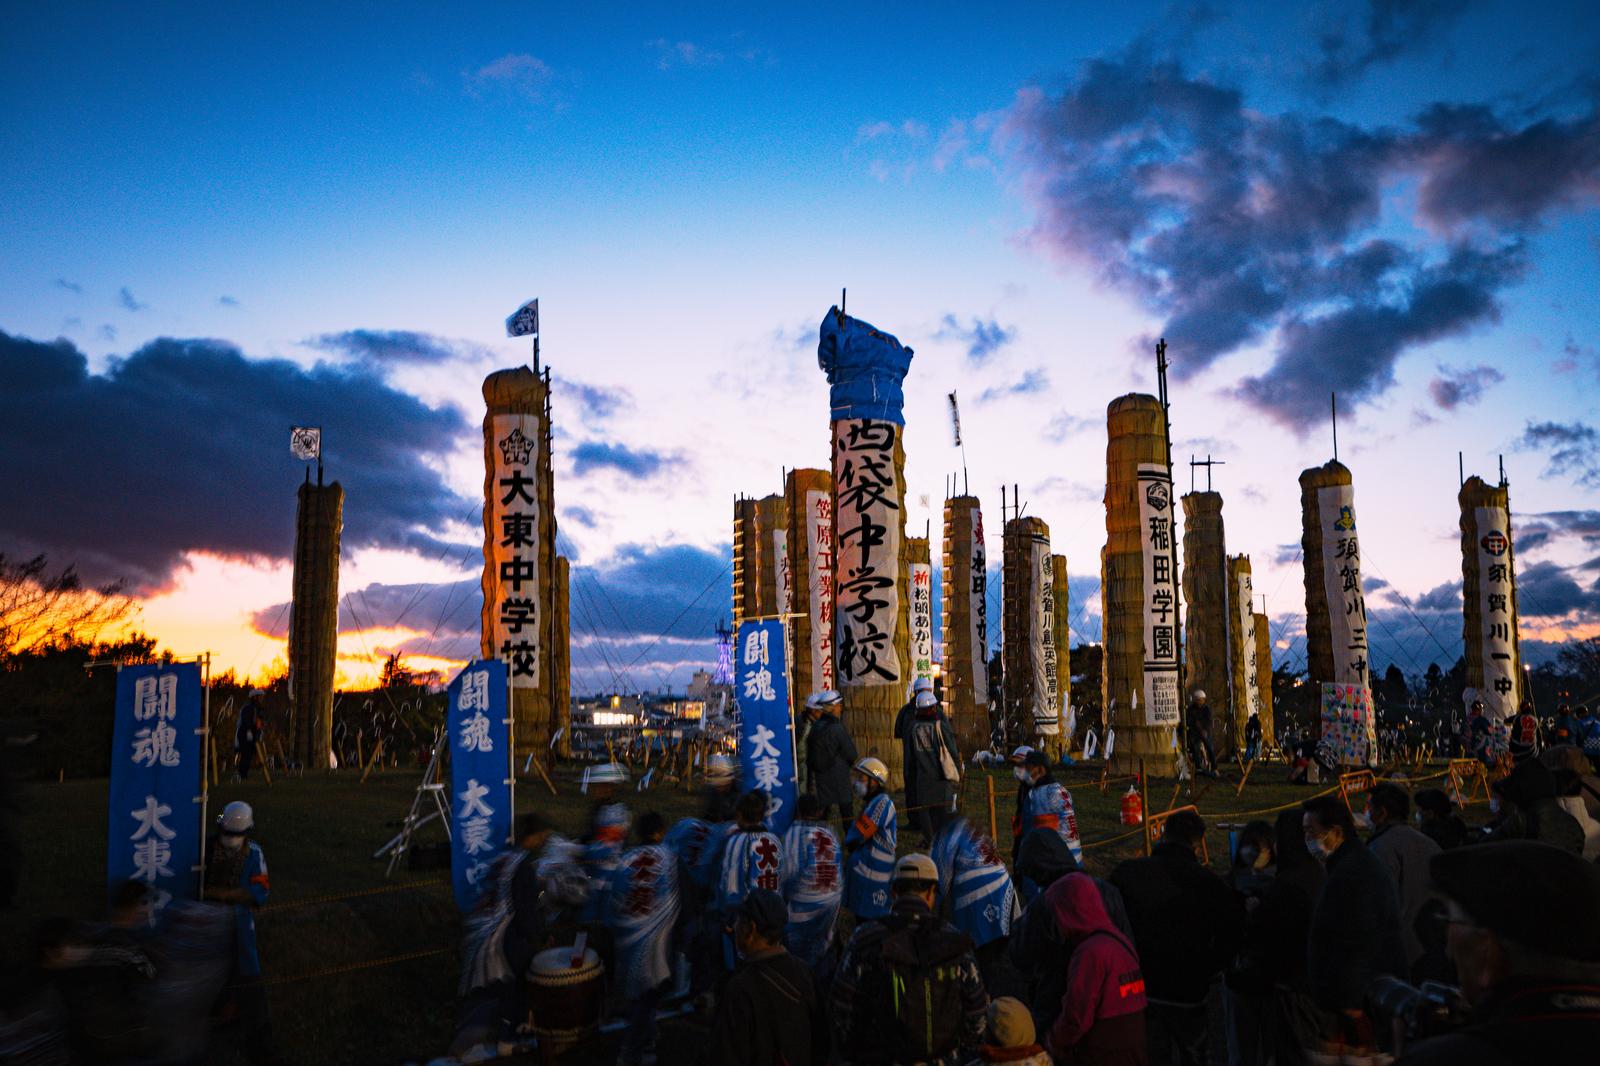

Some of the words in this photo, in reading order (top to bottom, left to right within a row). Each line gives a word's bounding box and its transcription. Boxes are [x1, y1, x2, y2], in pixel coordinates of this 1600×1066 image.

[500, 470, 535, 678] 大東中学校
[837, 418, 899, 682] 西袋中学校
[1149, 516, 1173, 659] 稲田学園
[1334, 537, 1368, 683] 須賀川三中
[743, 628, 777, 701] 闘魂
[914, 570, 931, 681] 祈松明あかし
[1488, 563, 1512, 696] 須賀川一中
[131, 671, 182, 768] 闘魂
[456, 669, 494, 752] 闘魂
